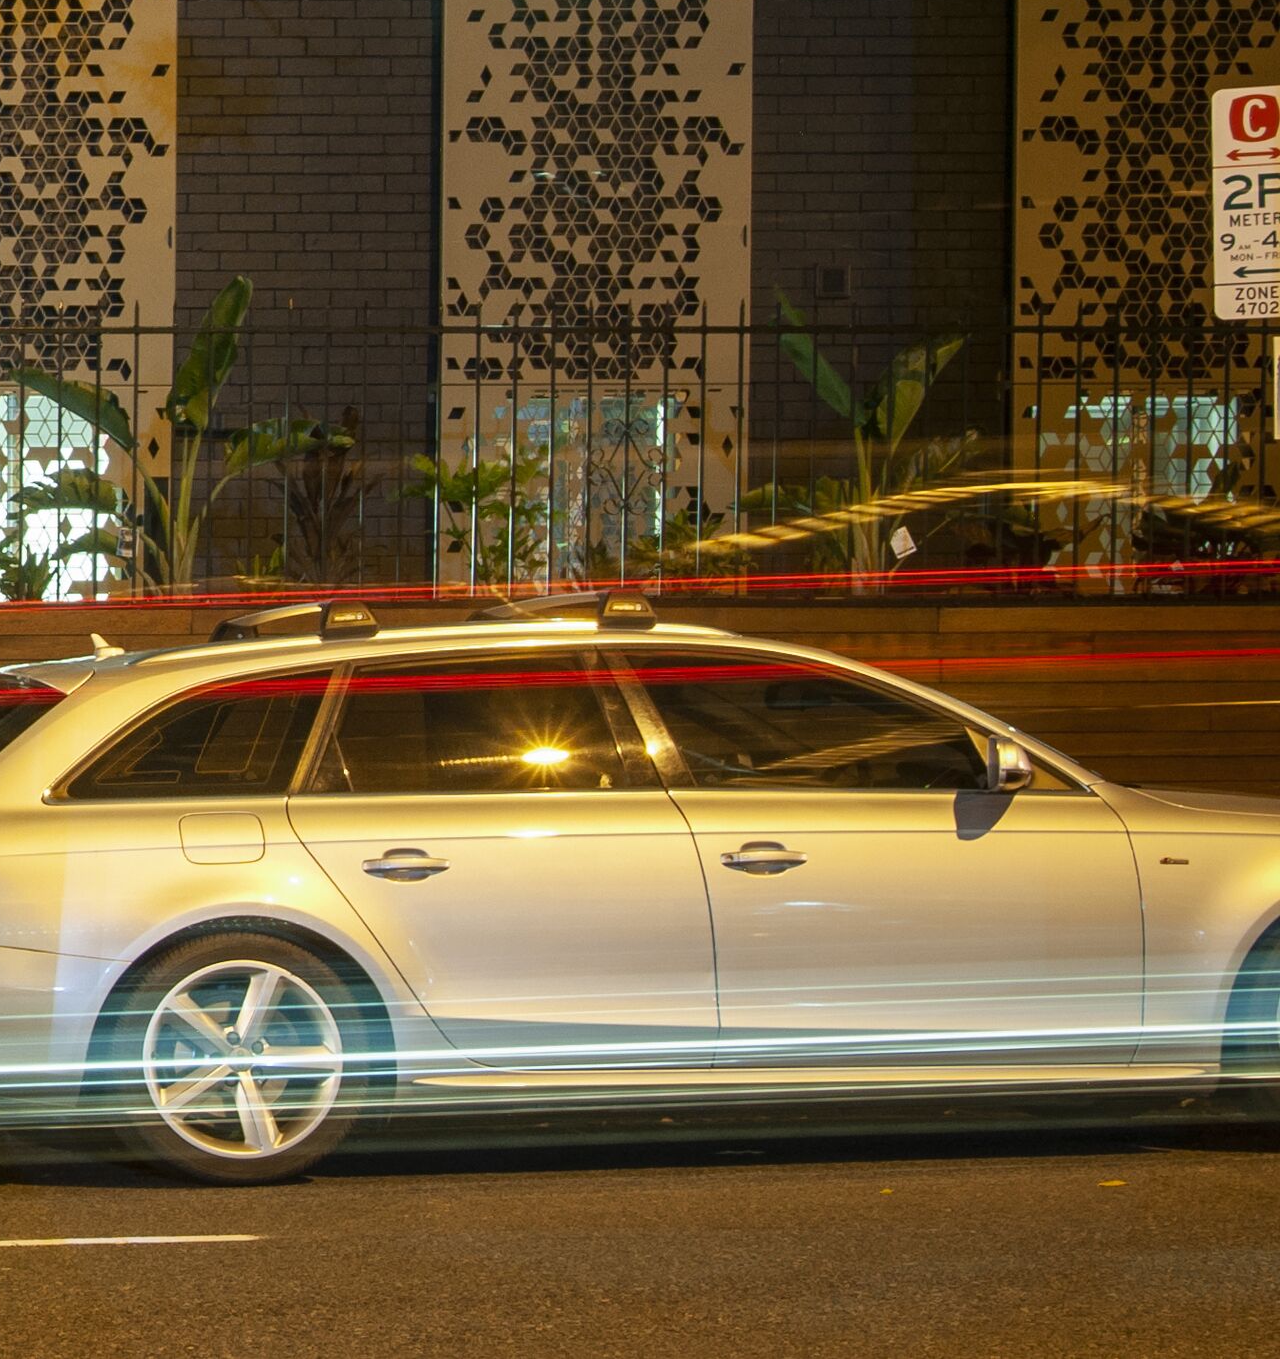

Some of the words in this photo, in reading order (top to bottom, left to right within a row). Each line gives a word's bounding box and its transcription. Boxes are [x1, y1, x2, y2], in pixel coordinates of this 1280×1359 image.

[1242, 98, 1267, 138] C
[1222, 173, 1280, 210] 2P
[1235, 285, 1279, 301] ZONE
[1235, 301, 1279, 315] 4702
